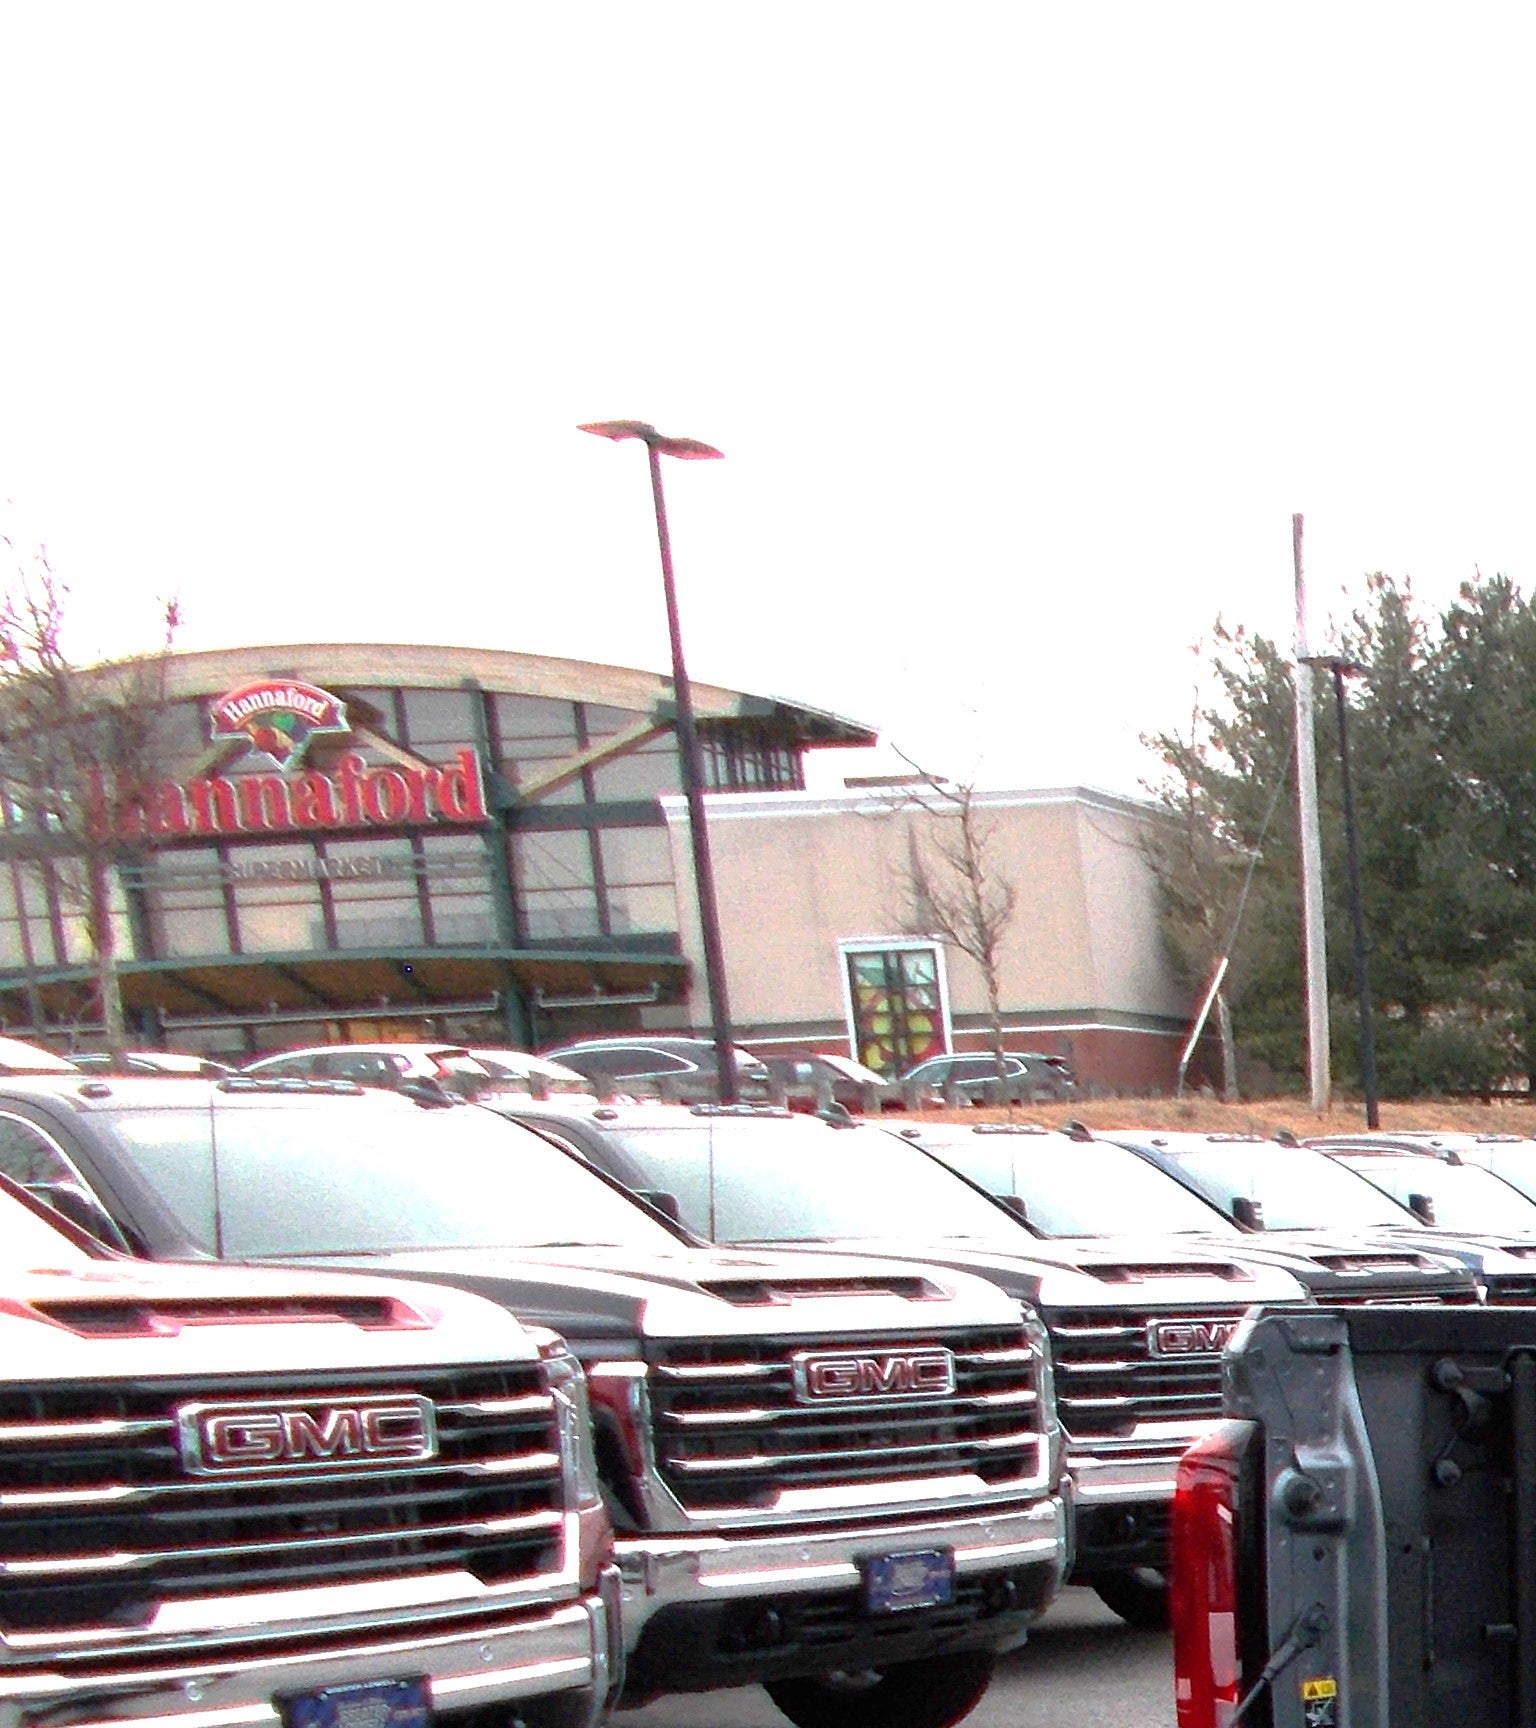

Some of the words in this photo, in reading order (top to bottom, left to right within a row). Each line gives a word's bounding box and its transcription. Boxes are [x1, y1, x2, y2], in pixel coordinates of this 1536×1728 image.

[221, 687, 330, 723] Hannaford
[1158, 1324, 1238, 1351] GM
[810, 1356, 949, 1395] GMC
[206, 1407, 424, 1462] GMC
